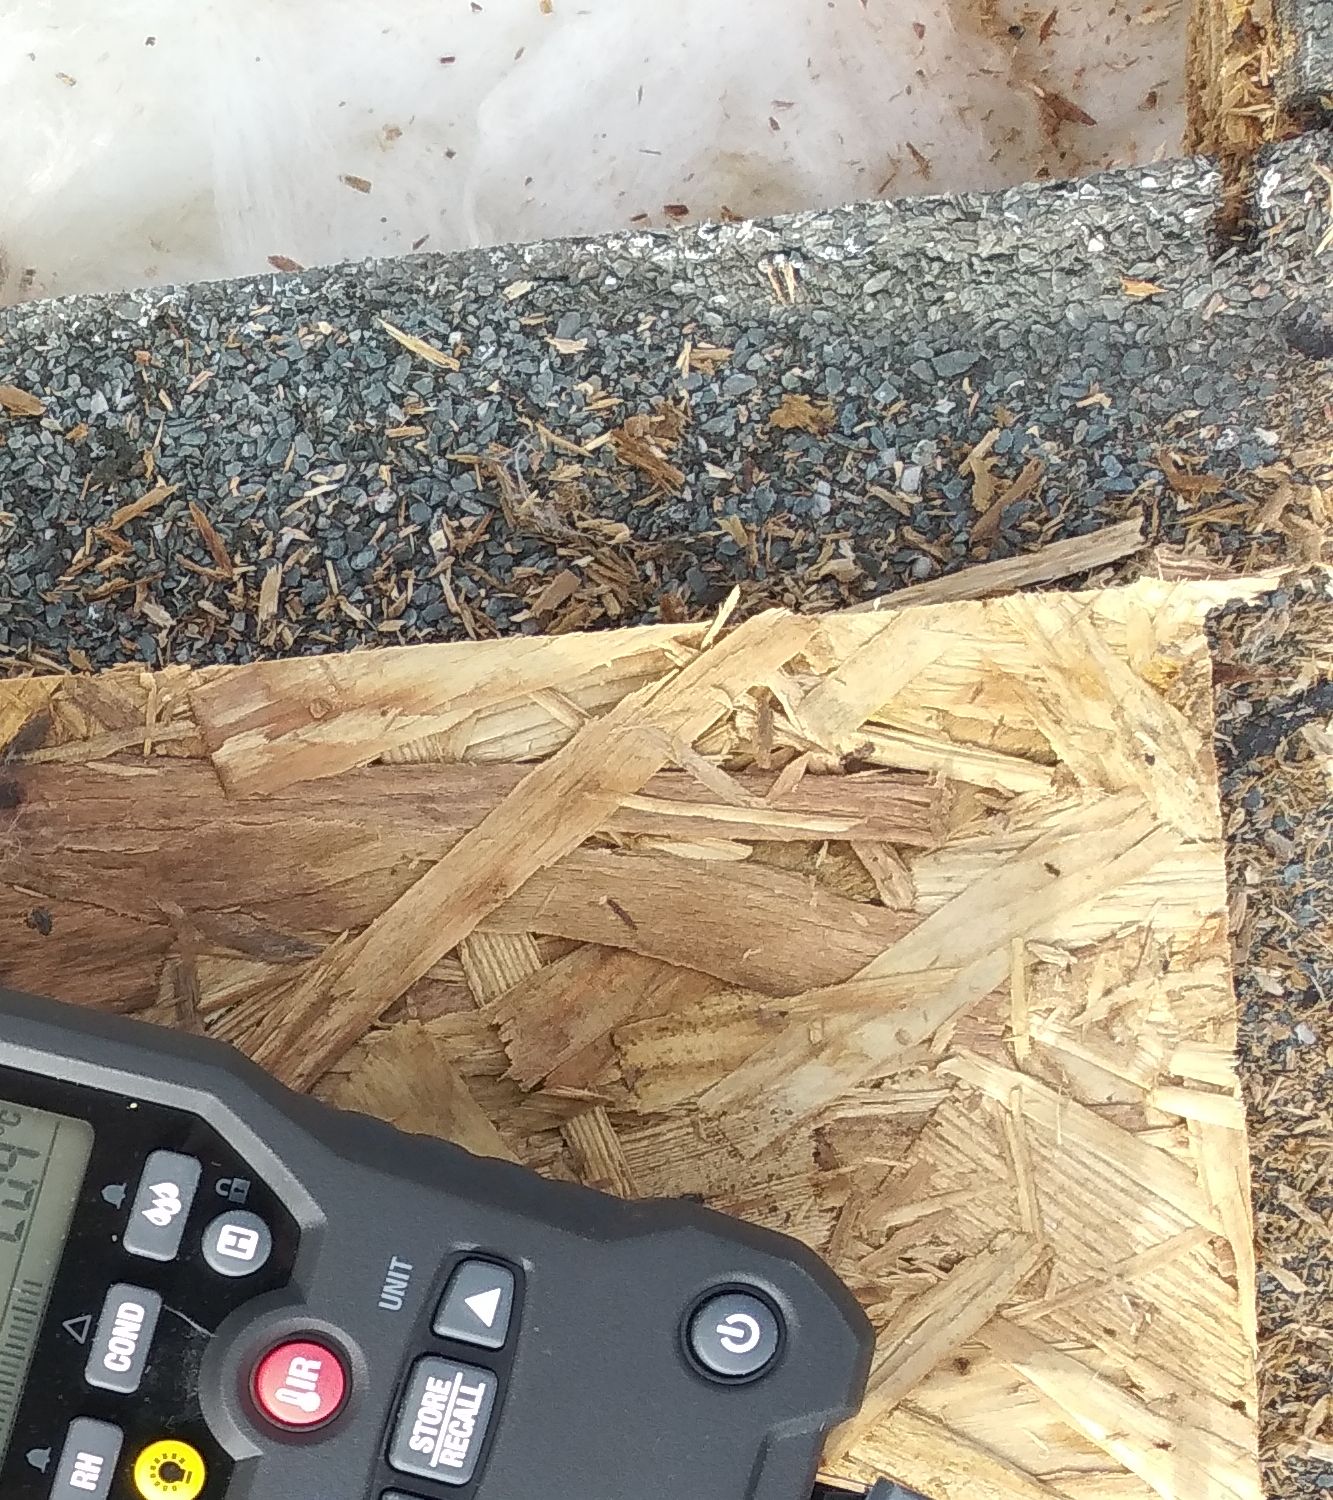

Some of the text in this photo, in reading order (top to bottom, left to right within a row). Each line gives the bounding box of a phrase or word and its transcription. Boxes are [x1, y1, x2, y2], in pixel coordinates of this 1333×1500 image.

[378, 1255, 413, 1312] UNIT
[103, 1301, 145, 1372] COND
[288, 1356, 322, 1391] IR
[409, 1376, 452, 1455] STORE
[438, 1380, 486, 1469] RECALL
[70, 1451, 104, 1491] RH
